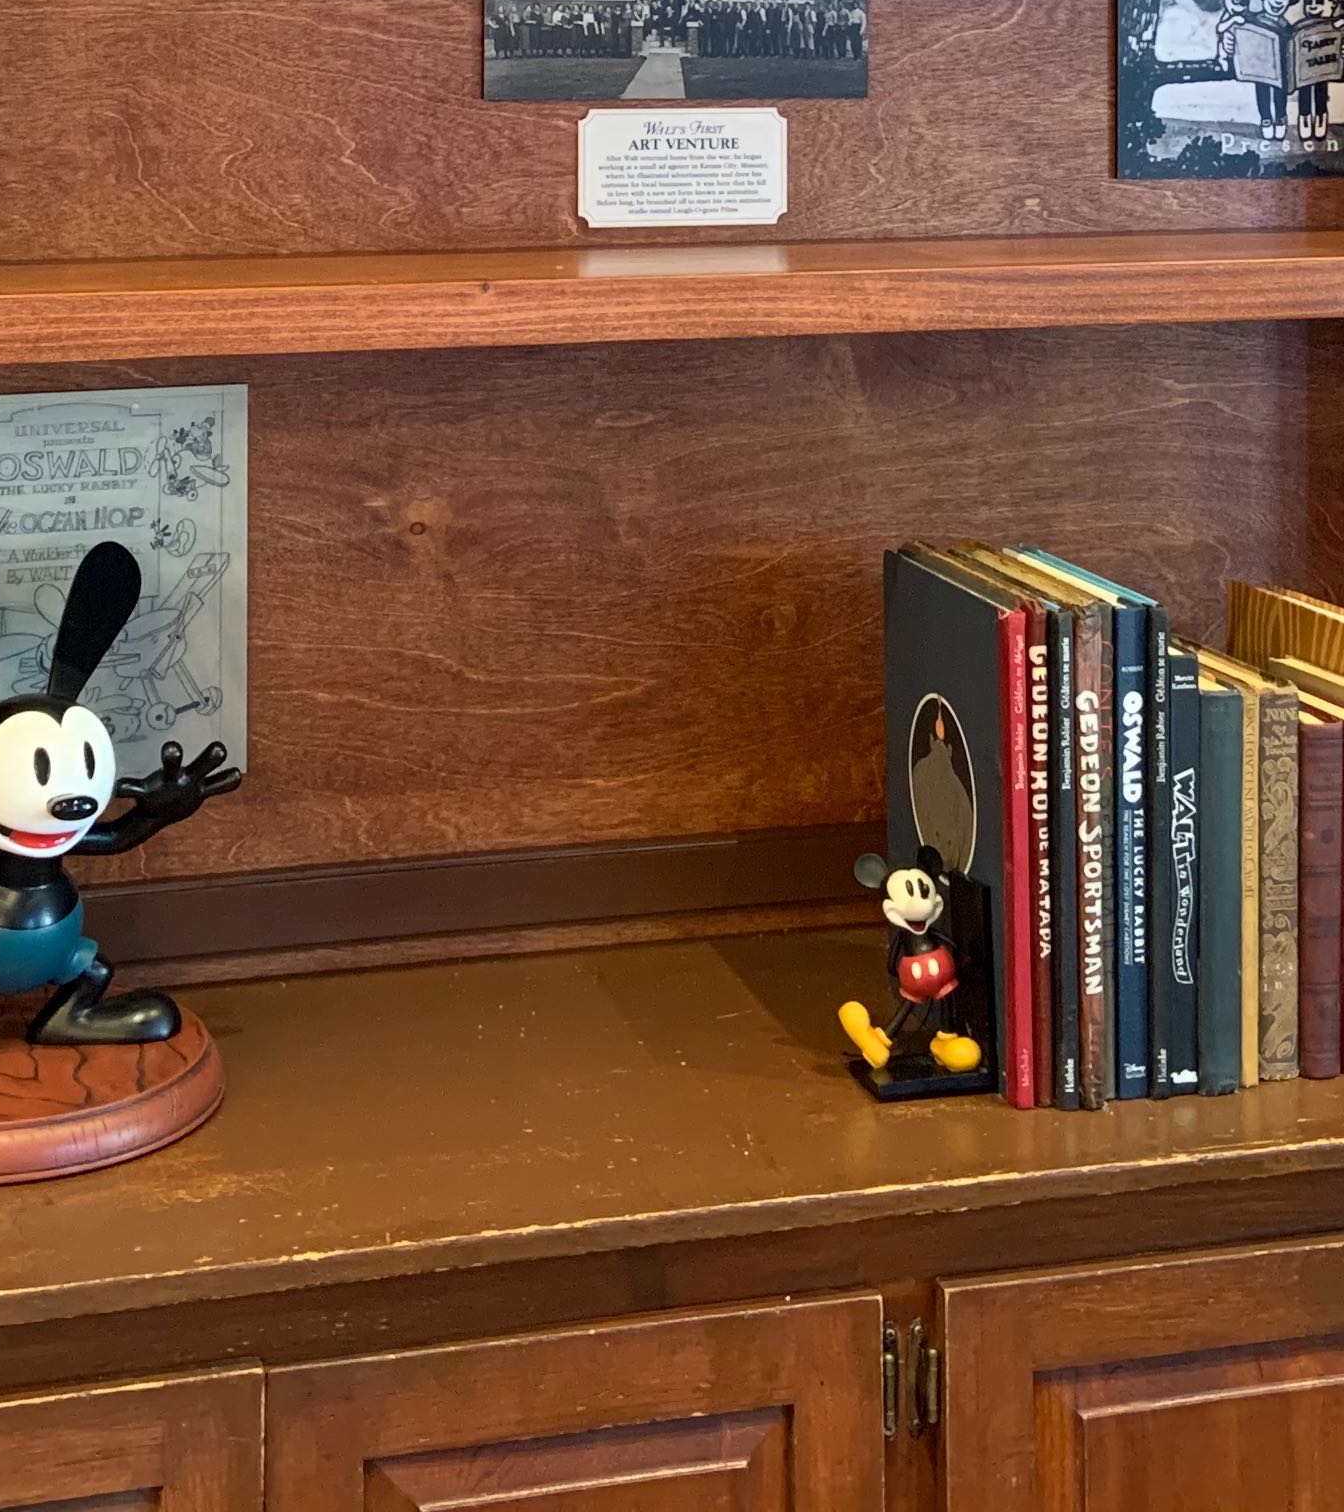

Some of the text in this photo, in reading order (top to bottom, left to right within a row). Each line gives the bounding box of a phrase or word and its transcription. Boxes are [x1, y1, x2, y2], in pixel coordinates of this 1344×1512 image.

[689, 119, 726, 135] FIRST
[627, 137, 740, 152] ART VENTURE
[14, 419, 126, 438] UNIVERSAL
[31, 482, 73, 495] LUCKY
[19, 509, 89, 535] OCEAN
[93, 504, 145, 529] HOP
[28, 565, 74, 583] WALT
[1122, 690, 1146, 965] OSWALD THE LUCKY RABBIT
[1244, 805, 1256, 843] DRAW
[1075, 689, 1104, 996] GEDEON SPORTSMAN
[1171, 767, 1197, 978] WALT in Wonderland
[1243, 864, 1256, 900] HOW
[1038, 858, 1052, 959] MATAPA
